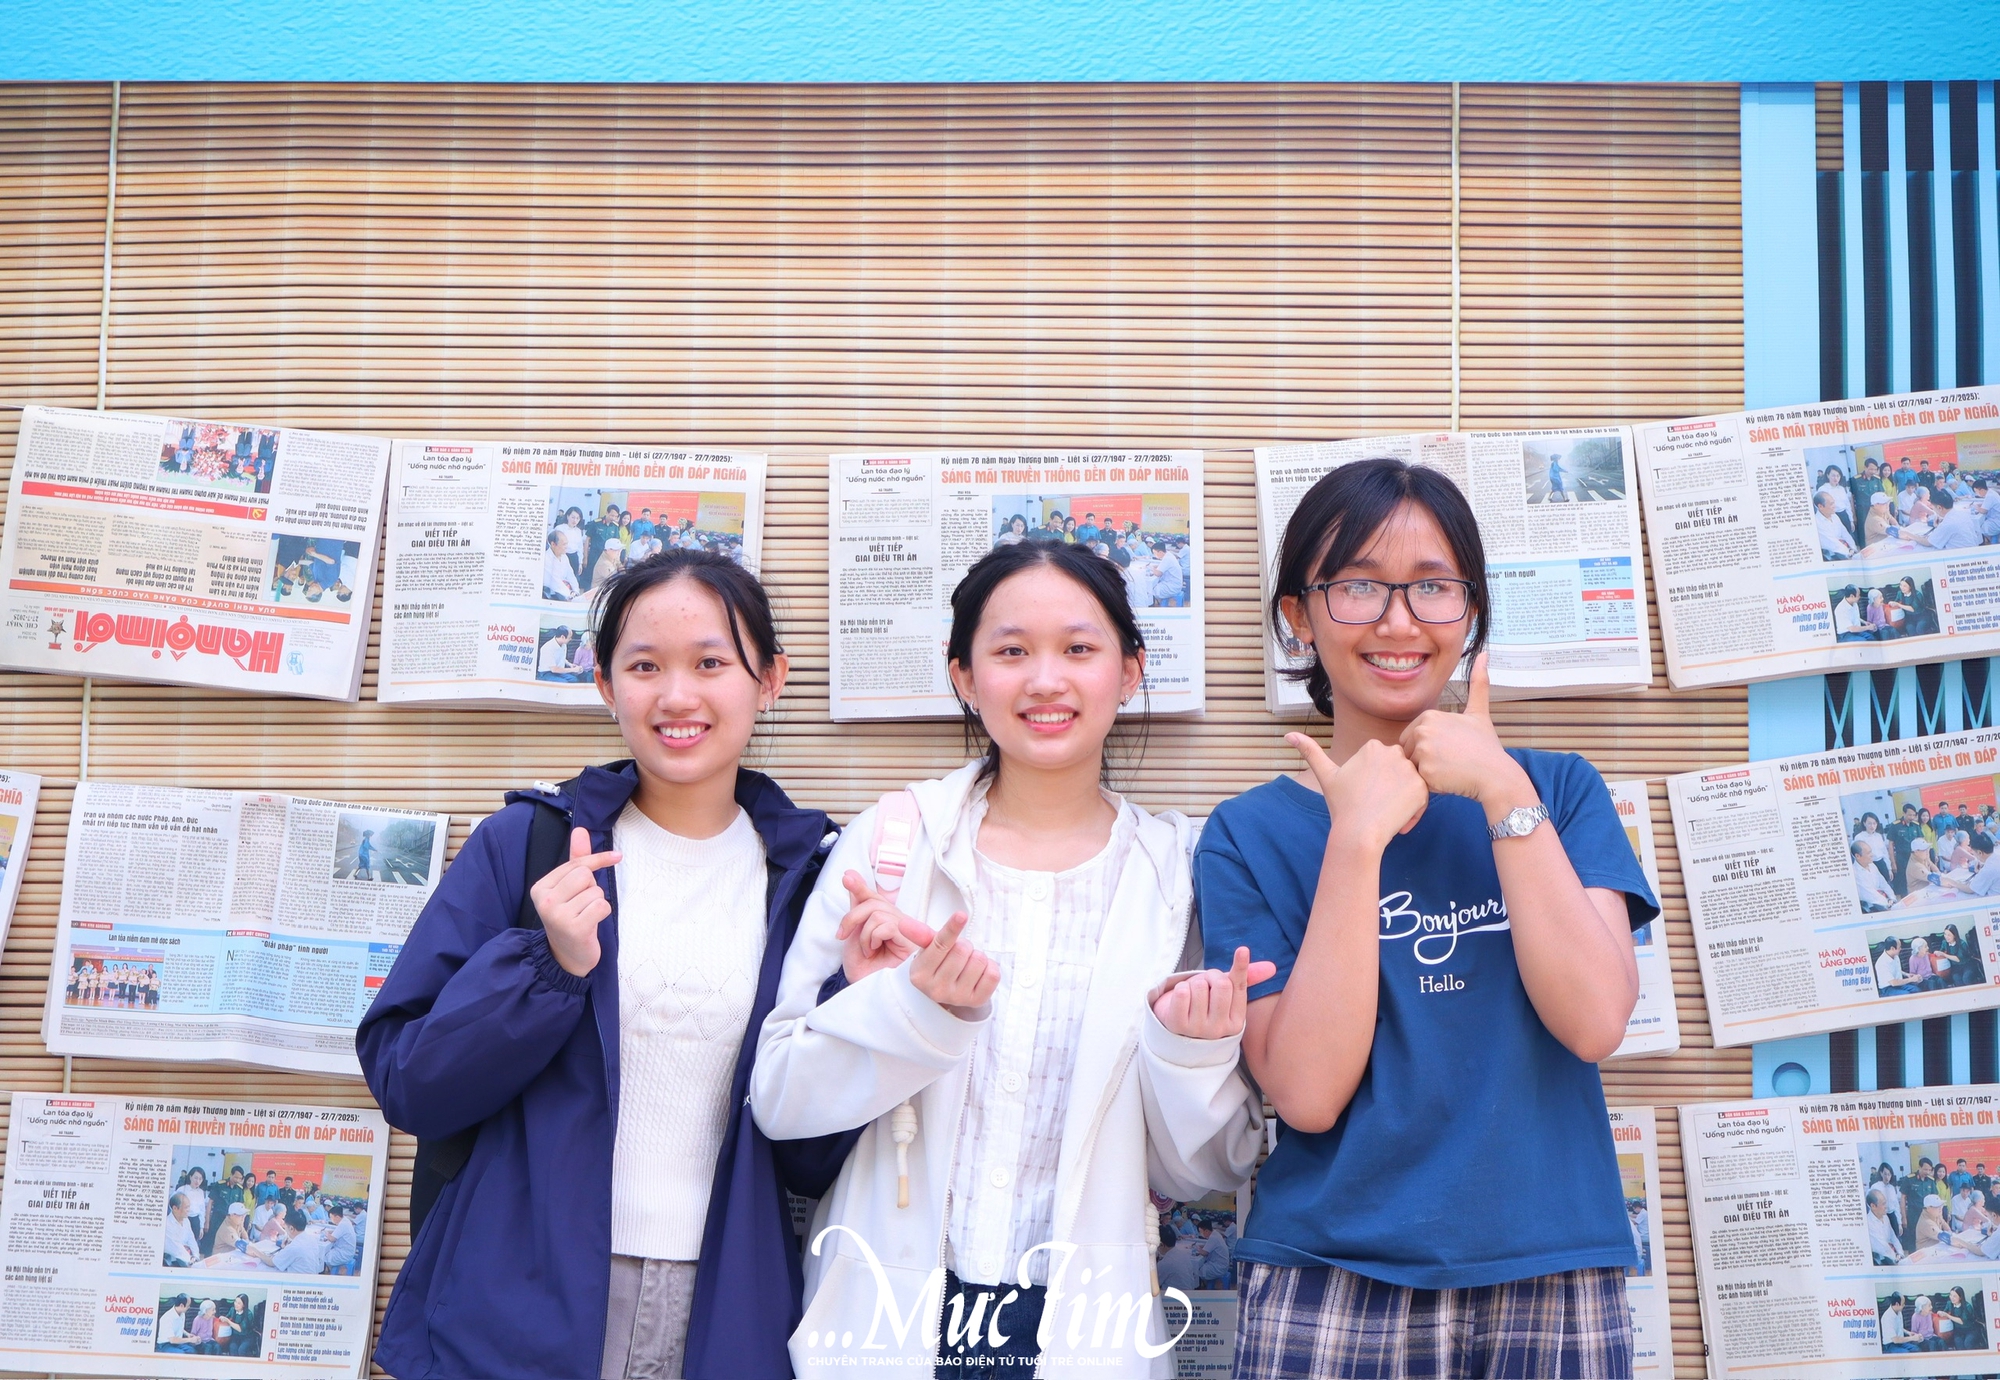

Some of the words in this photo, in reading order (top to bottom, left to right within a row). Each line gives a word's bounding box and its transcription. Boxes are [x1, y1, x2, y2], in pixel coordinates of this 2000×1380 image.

[1749, 426, 1780, 443] SÁNG
[1782, 422, 1806, 439] MÃI
[1808, 417, 1849, 436] TRUYỀN
[1852, 414, 1890, 431] THỐNG
[1893, 410, 1916, 427] ĐỀN
[1919, 410, 1935, 424] ƠN
[1938, 406, 1961, 423] ĐÁP
[1964, 402, 1999, 420] NGHĨA
[501, 459, 531, 474] SÁNG
[535, 460, 558, 475] MÃI
[561, 461, 601, 476] TRUYỀN
[605, 461, 640, 477] THỐNG
[644, 462, 666, 478] ĐỀN
[669, 464, 684, 479] ƠN
[688, 464, 710, 479] ĐÁP
[713, 466, 747, 481] NGHĨA
[941, 468, 971, 484] SÁNG
[975, 467, 997, 483] MÃI
[1001, 465, 1041, 483] TRUYỀN
[1044, 465, 1080, 483] THỐNG
[1084, 464, 1106, 482] ĐỀN
[1110, 467, 1125, 482] ƠN
[1128, 465, 1152, 481] ĐÁP
[1155, 465, 1189, 481] NGHĨA
[1687, 508, 1703, 518] VIẾT
[1706, 506, 1722, 516] TIẾP
[1675, 521, 1691, 530] GIAI
[1693, 518, 1711, 528] ĐIỆU
[1713, 516, 1726, 525] TRI
[1728, 514, 1738, 523] ÂN
[869, 542, 885, 552] VIẾT
[887, 542, 903, 552] TIẾP
[873, 553, 890, 562] ĐIỆU
[907, 552, 917, 561] ÂN
[80, 587, 103, 595] SỐNG
[153, 594, 177, 602] ĐẢNG
[181, 597, 198, 605] CỦA
[201, 601, 230, 609] QUYẾT
[1776, 596, 1789, 605] HÀ
[1789, 594, 1805, 603] NỘI
[233, 603, 254, 612] NGHỊ
[1778, 605, 1801, 614] LẮNG
[1801, 601, 1827, 611] ĐỌNG
[1783, 774, 1815, 791] SÁNG
[1817, 768, 1841, 786] MÃI
[1842, 763, 1886, 782] TRUYỀN
[1887, 758, 1926, 776] THỐNG
[1928, 754, 1952, 771] ĐỀN
[1955, 751, 1972, 767] ƠN
[1974, 747, 1997, 764] ĐÁP
[0, 788, 23, 805] GHĨA
[1616, 800, 1635, 815] HĨA
[1419, 974, 1465, 993] Hello
[125, 1101, 134, 1111] Kỷ
[155, 1103, 164, 1112] 78
[166, 1104, 181, 1113] năm
[203, 1106, 228, 1116] Thương
[229, 1107, 245, 1116] binh
[254, 1108, 267, 1118] Liệt
[277, 1110, 313, 1119] (27/7/1947
[321, 1112, 360, 1122] 27/7/2025):
[1802, 1116, 1833, 1134] SÁNG
[1835, 1115, 1860, 1132] MÃI
[1862, 1112, 1905, 1131] TRUYỀN
[1907, 1110, 1947, 1128] THỐNG
[1950, 1108, 1974, 1126] ĐỀN
[1977, 1109, 1994, 1125] ƠN
[124, 1115, 154, 1132] SÁNG
[157, 1116, 181, 1133] MÃI
[184, 1118, 226, 1135] TRUYỀN
[229, 1119, 265, 1138] THỐNG
[269, 1120, 291, 1139] ĐỀN
[294, 1124, 310, 1140] ƠN
[313, 1124, 337, 1141] ĐÁP
[339, 1126, 374, 1143] NGHĨA
[1612, 1125, 1642, 1141] GHĨA
[105, 1294, 118, 1303] HÀ
[119, 1295, 134, 1304] NỘI
[104, 1304, 127, 1313] LẮNG
[128, 1306, 154, 1315] ĐỌNG
